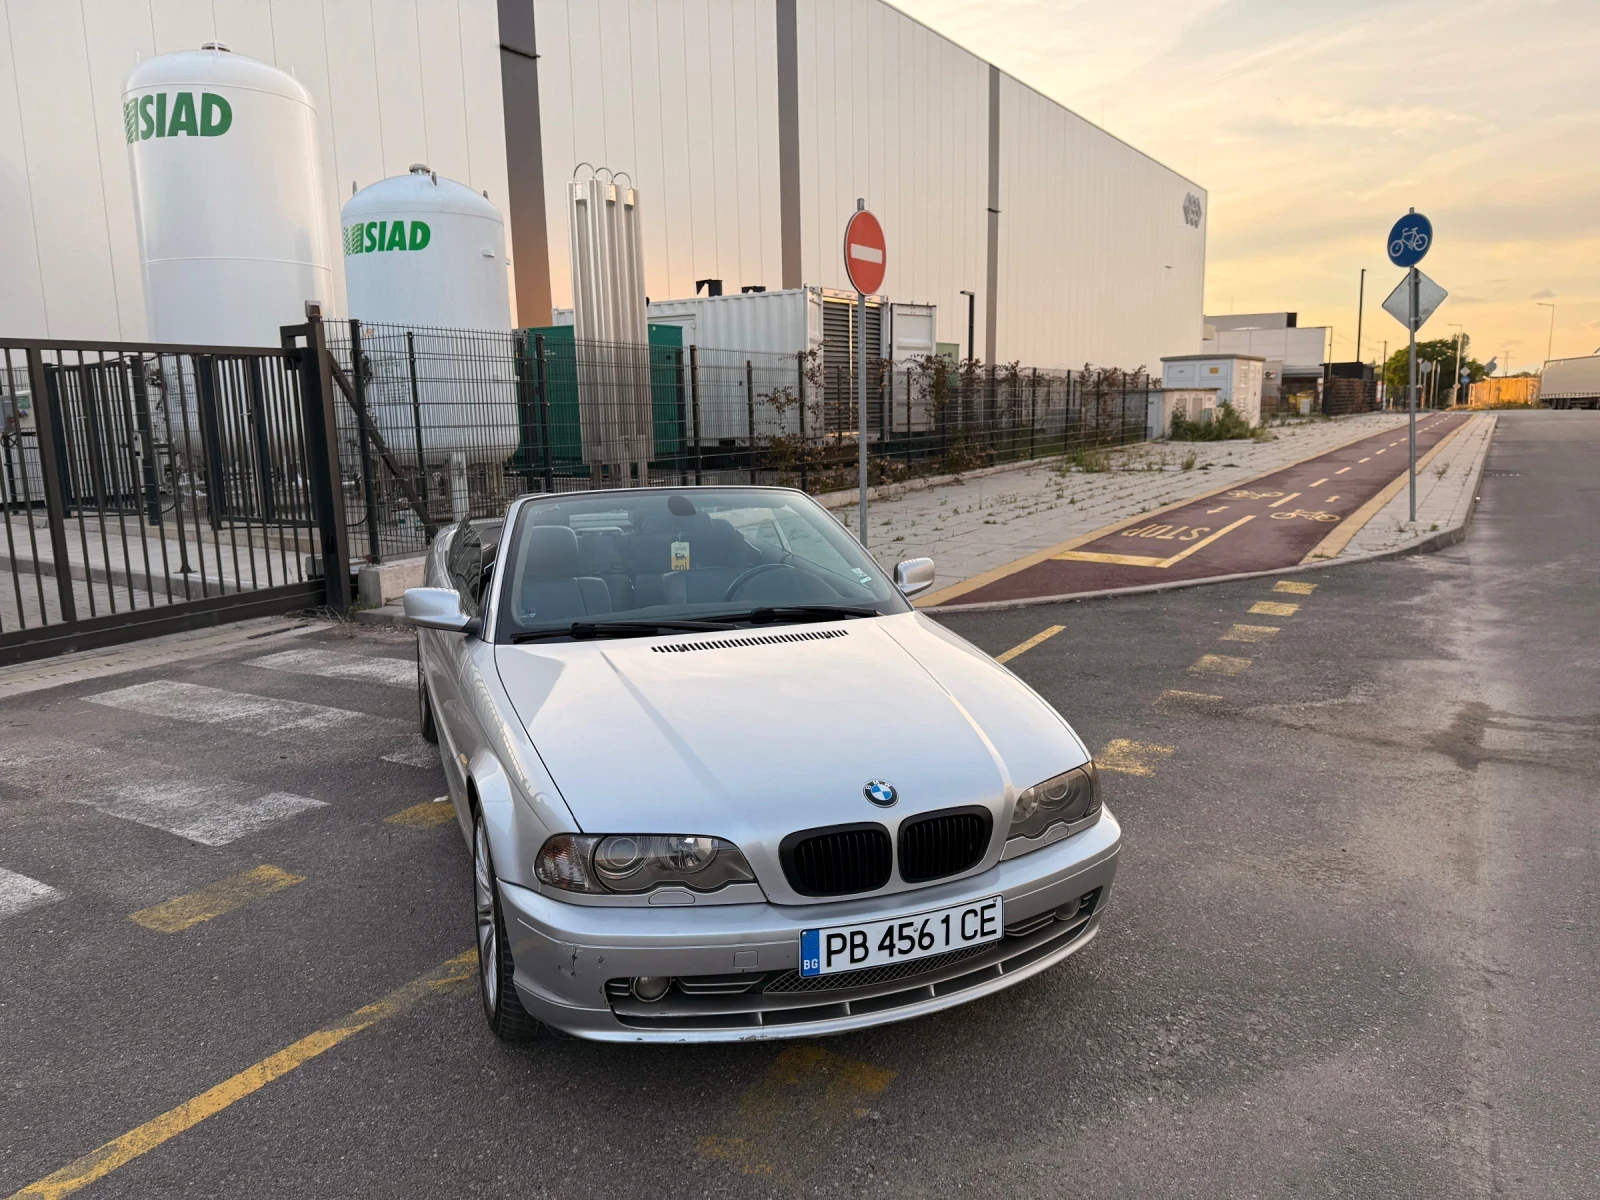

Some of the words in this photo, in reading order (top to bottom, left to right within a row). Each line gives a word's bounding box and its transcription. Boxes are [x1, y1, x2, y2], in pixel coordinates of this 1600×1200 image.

[139, 92, 232, 140] SIAD
[364, 220, 431, 252] SIAD
[1121, 524, 1211, 540] STOP
[826, 931, 869, 967] PB
[878, 914, 951, 957] 4561
[961, 903, 997, 940] CE
[803, 958, 819, 970] BG
